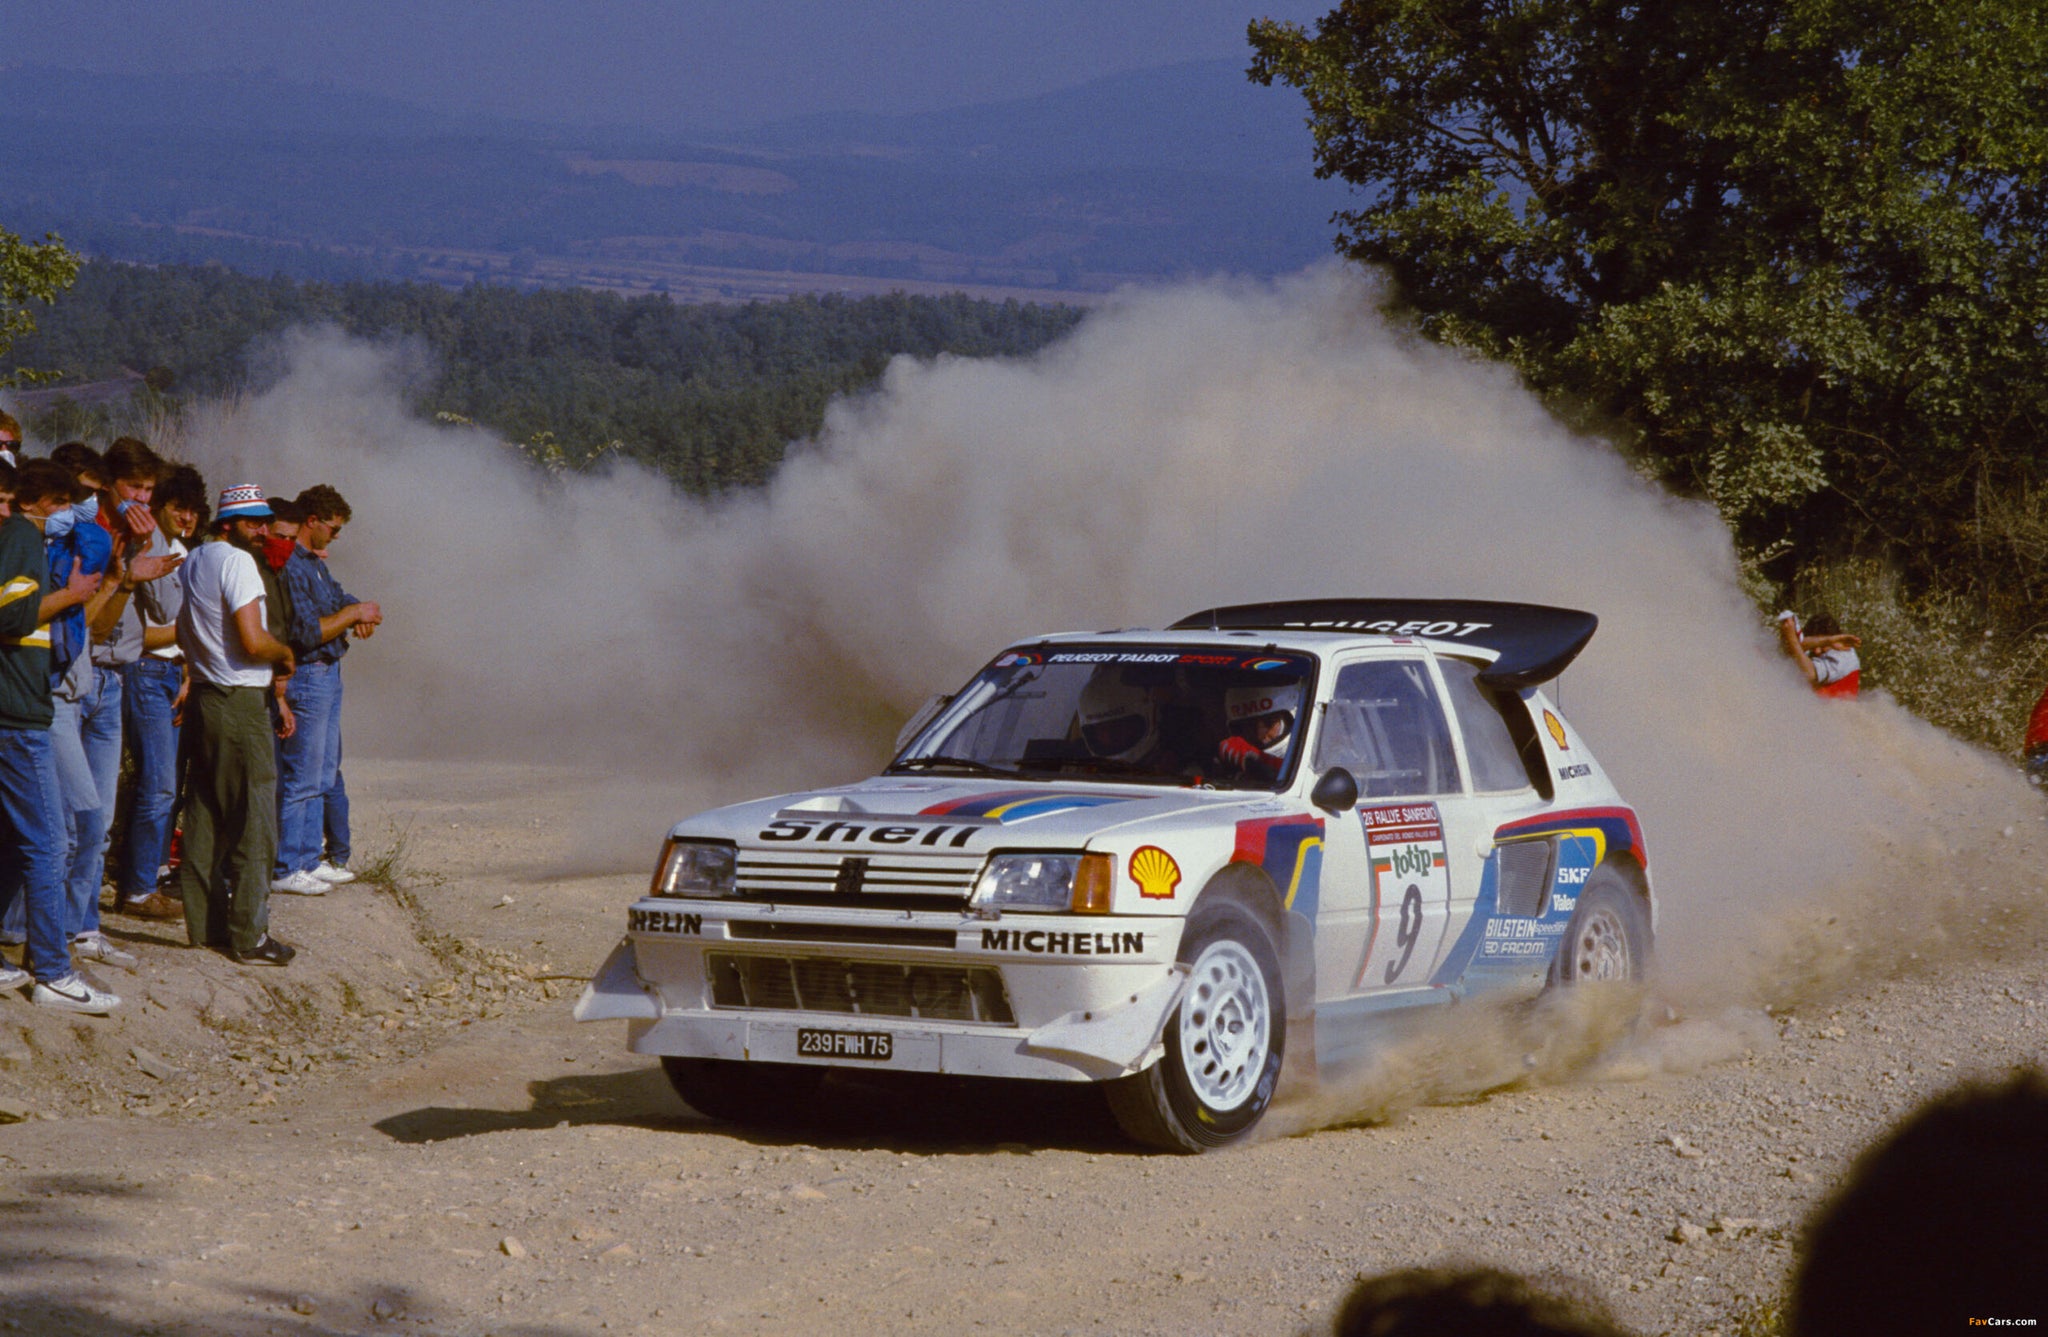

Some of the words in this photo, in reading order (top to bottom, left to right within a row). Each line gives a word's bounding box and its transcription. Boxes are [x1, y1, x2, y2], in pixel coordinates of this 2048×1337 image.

[1048, 653, 1119, 663] PEUGEOT
[1117, 654, 1179, 663] TALBOT
[1177, 655, 1237, 665] SPORT
[1558, 763, 1592, 780] MICHELIN
[1375, 809, 1402, 824] RALLYE
[1402, 807, 1437, 822] SANREMO
[759, 821, 982, 847] Shell
[1392, 844, 1431, 879] totip
[1558, 868, 1591, 884] SKF
[1553, 894, 1576, 911] Valeo
[1384, 883, 1423, 985] 9
[1485, 918, 1537, 937] BILSTEIN
[982, 928, 1143, 954] MICHELIN
[1501, 941, 1544, 954] FACOM
[802, 1032, 832, 1053] 239
[835, 1034, 865, 1054] FWH
[867, 1036, 888, 1055] 75
